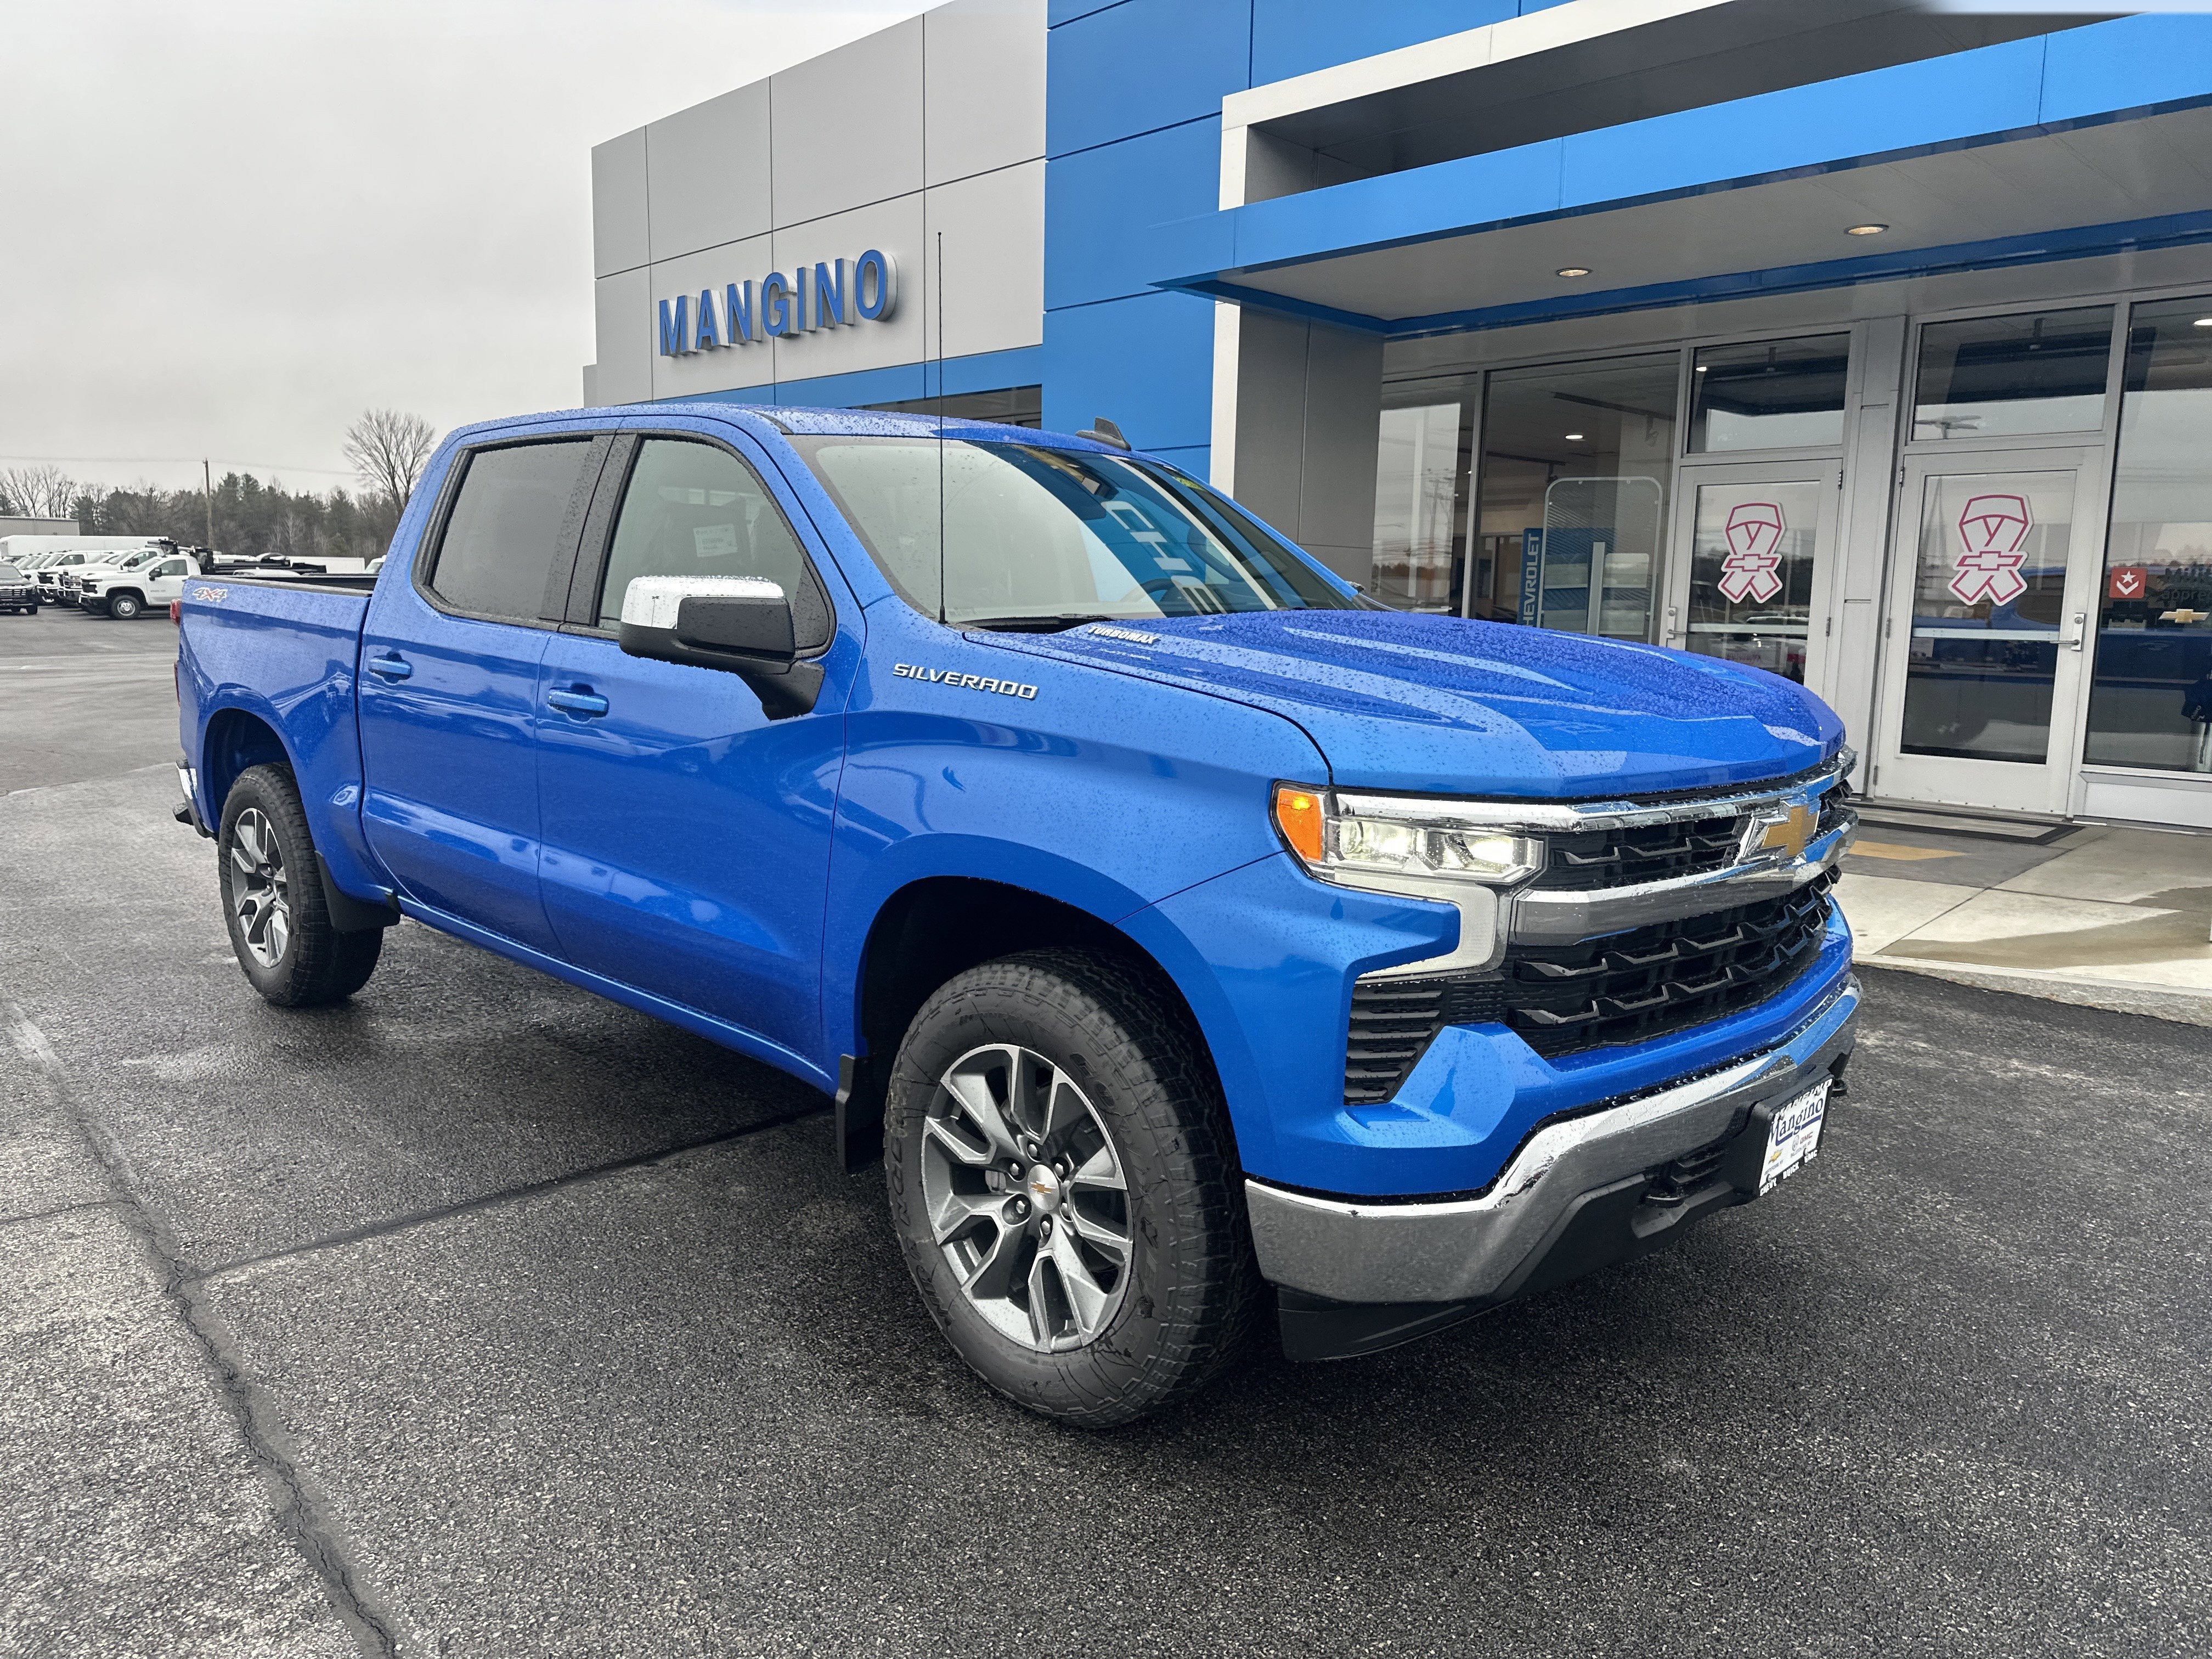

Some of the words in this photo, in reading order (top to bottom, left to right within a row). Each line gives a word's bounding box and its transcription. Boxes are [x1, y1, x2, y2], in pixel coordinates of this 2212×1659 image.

[659, 250, 898, 357] MANGINO
[1523, 533, 1539, 627] HEVROLET
[1088, 626, 1159, 644] TURBOMAX
[893, 663, 1040, 701] SILVERADO
[1770, 1098, 1824, 1144] Mangino
[1782, 1161, 1799, 1180] BUICK
[1804, 1149, 1818, 1163] GMC
[1759, 1177, 1777, 1197] CHEVY
